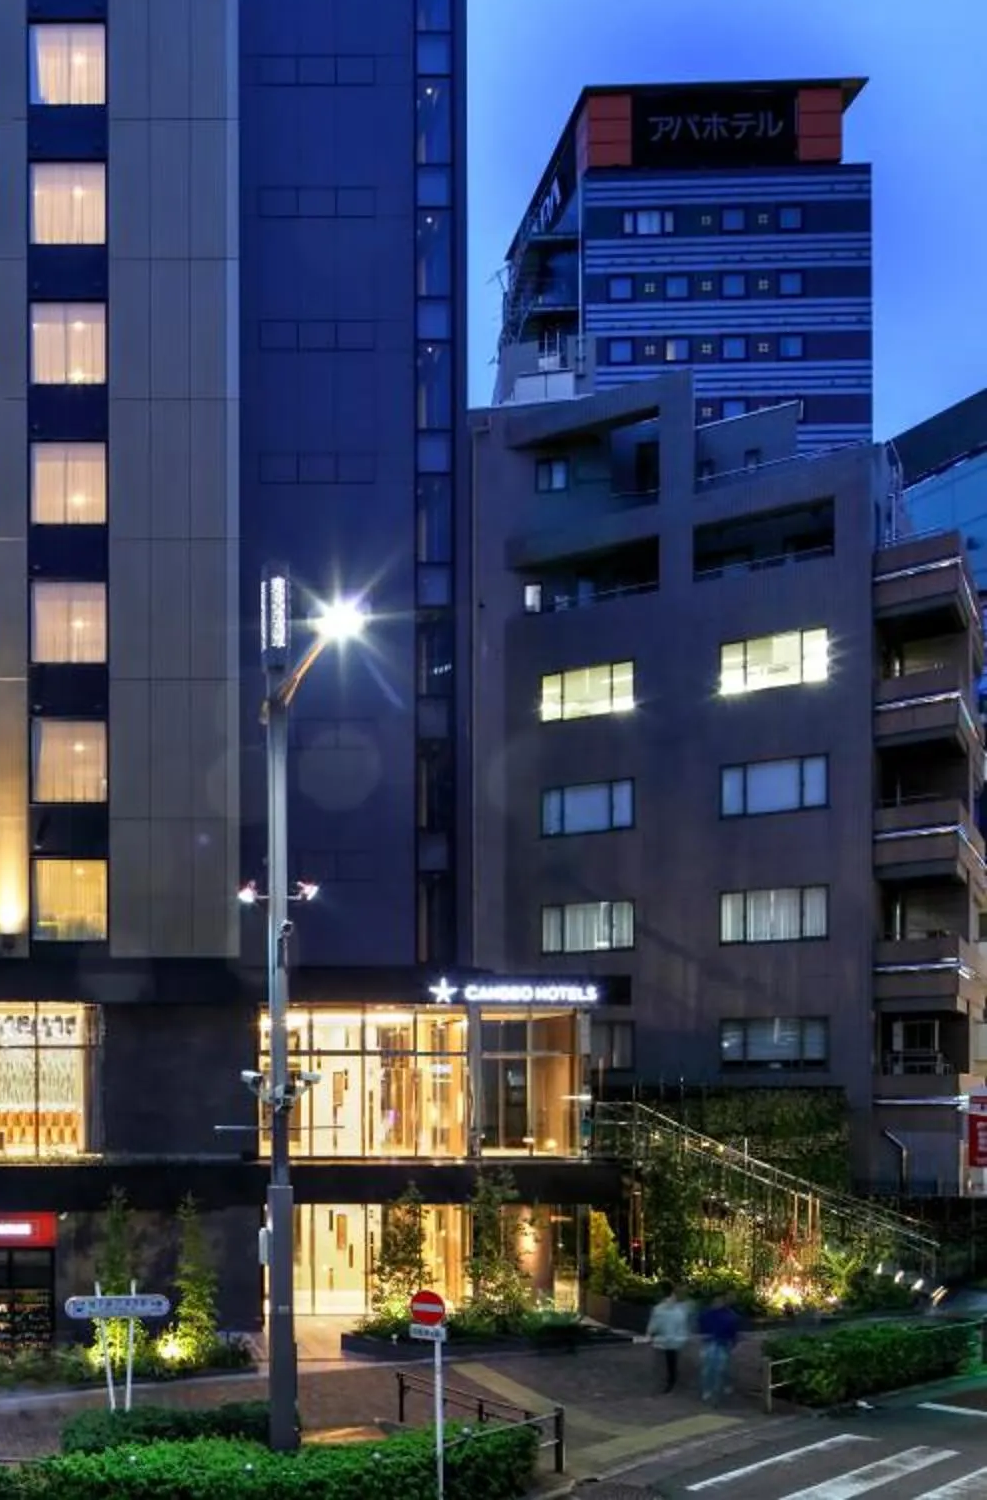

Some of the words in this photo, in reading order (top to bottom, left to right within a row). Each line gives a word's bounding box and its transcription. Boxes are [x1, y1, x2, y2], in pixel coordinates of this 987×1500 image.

[647, 110, 784, 141] アパホテル
[464, 985, 534, 1001] CANDEO
[535, 985, 598, 1001] HOTELS
